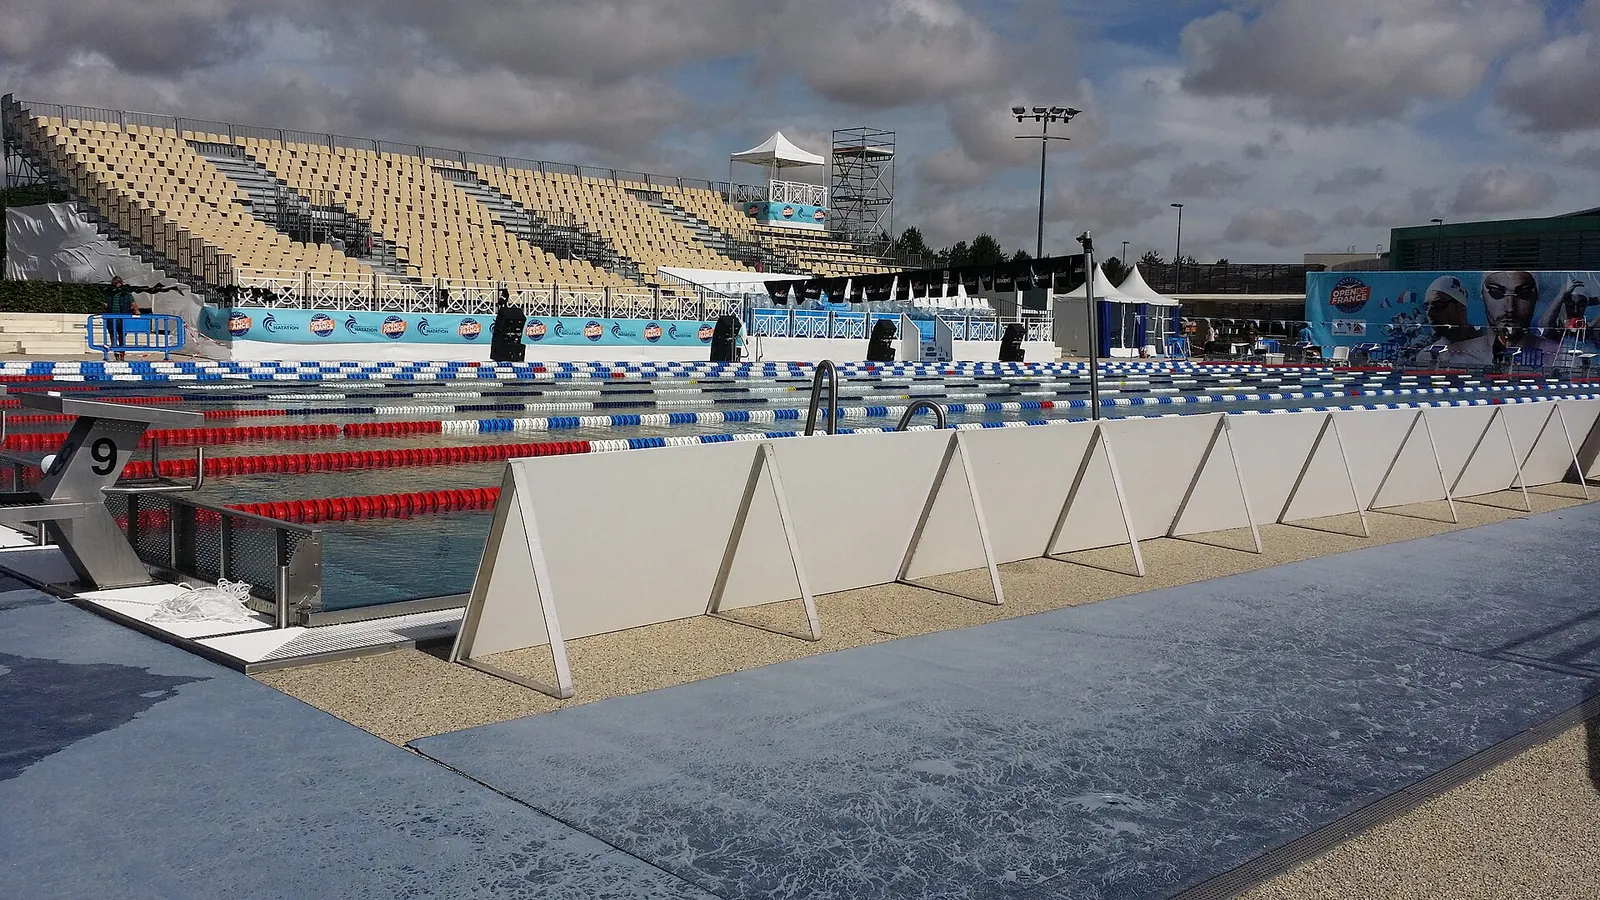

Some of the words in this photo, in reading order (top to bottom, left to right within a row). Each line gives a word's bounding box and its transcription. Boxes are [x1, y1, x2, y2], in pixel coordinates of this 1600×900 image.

[1333, 288, 1357, 297] OPEN
[1331, 294, 1367, 304] FRANCE
[91, 437, 117, 475] 9
